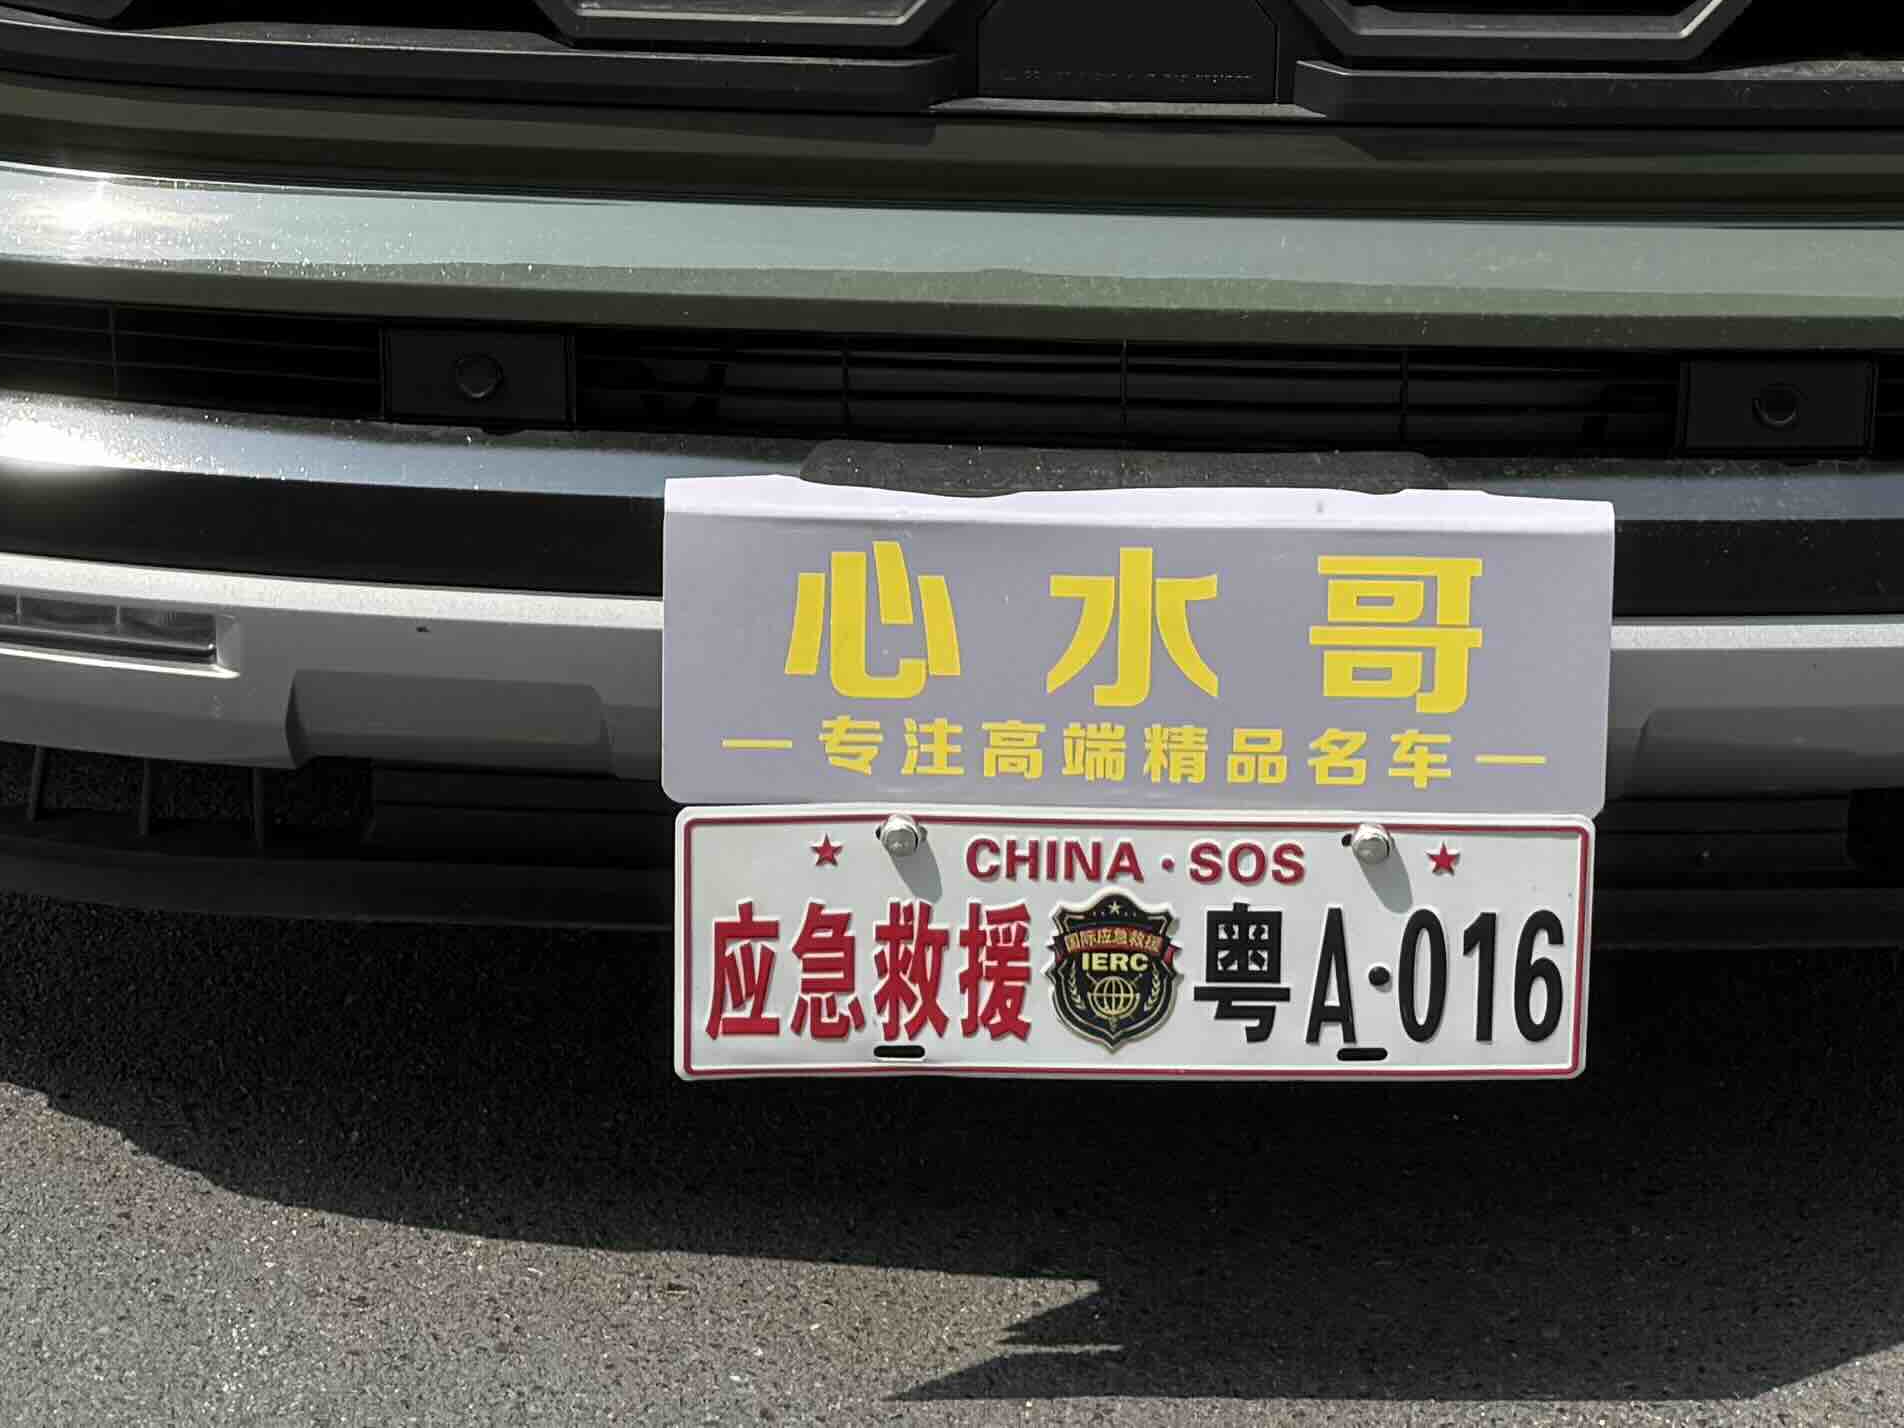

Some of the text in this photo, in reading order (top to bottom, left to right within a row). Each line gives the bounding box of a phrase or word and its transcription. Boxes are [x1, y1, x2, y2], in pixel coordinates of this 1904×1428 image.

[783, 540, 1483, 713] 心水哥
[817, 714, 1453, 790] 专注高端精品名车
[704, 900, 1033, 1042] 应急救援
[1081, 952, 1149, 973] IERC
